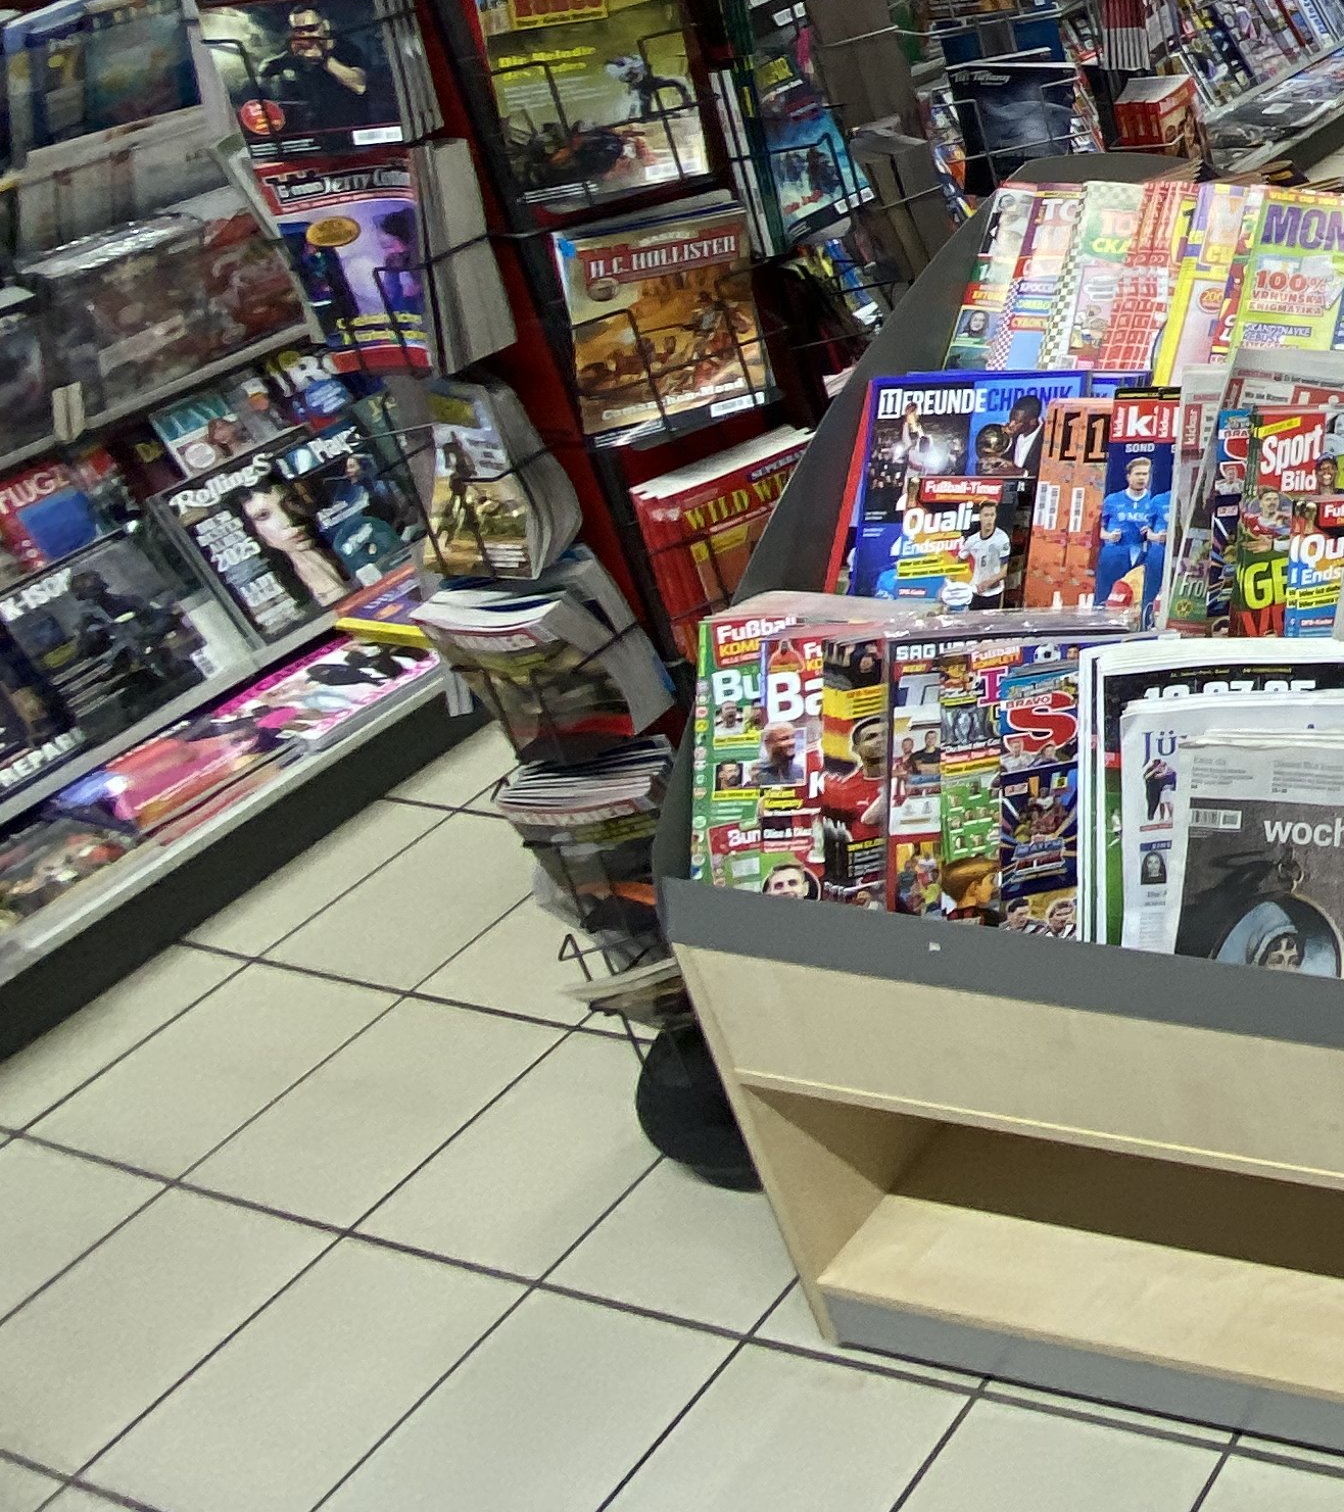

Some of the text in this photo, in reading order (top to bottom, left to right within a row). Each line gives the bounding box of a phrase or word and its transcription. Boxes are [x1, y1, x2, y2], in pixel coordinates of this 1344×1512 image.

[1261, 423, 1323, 475] Sport
[1280, 471, 1317, 492] Bild
[902, 502, 980, 539] Quali-
[1005, 695, 1051, 709] BRAVO
